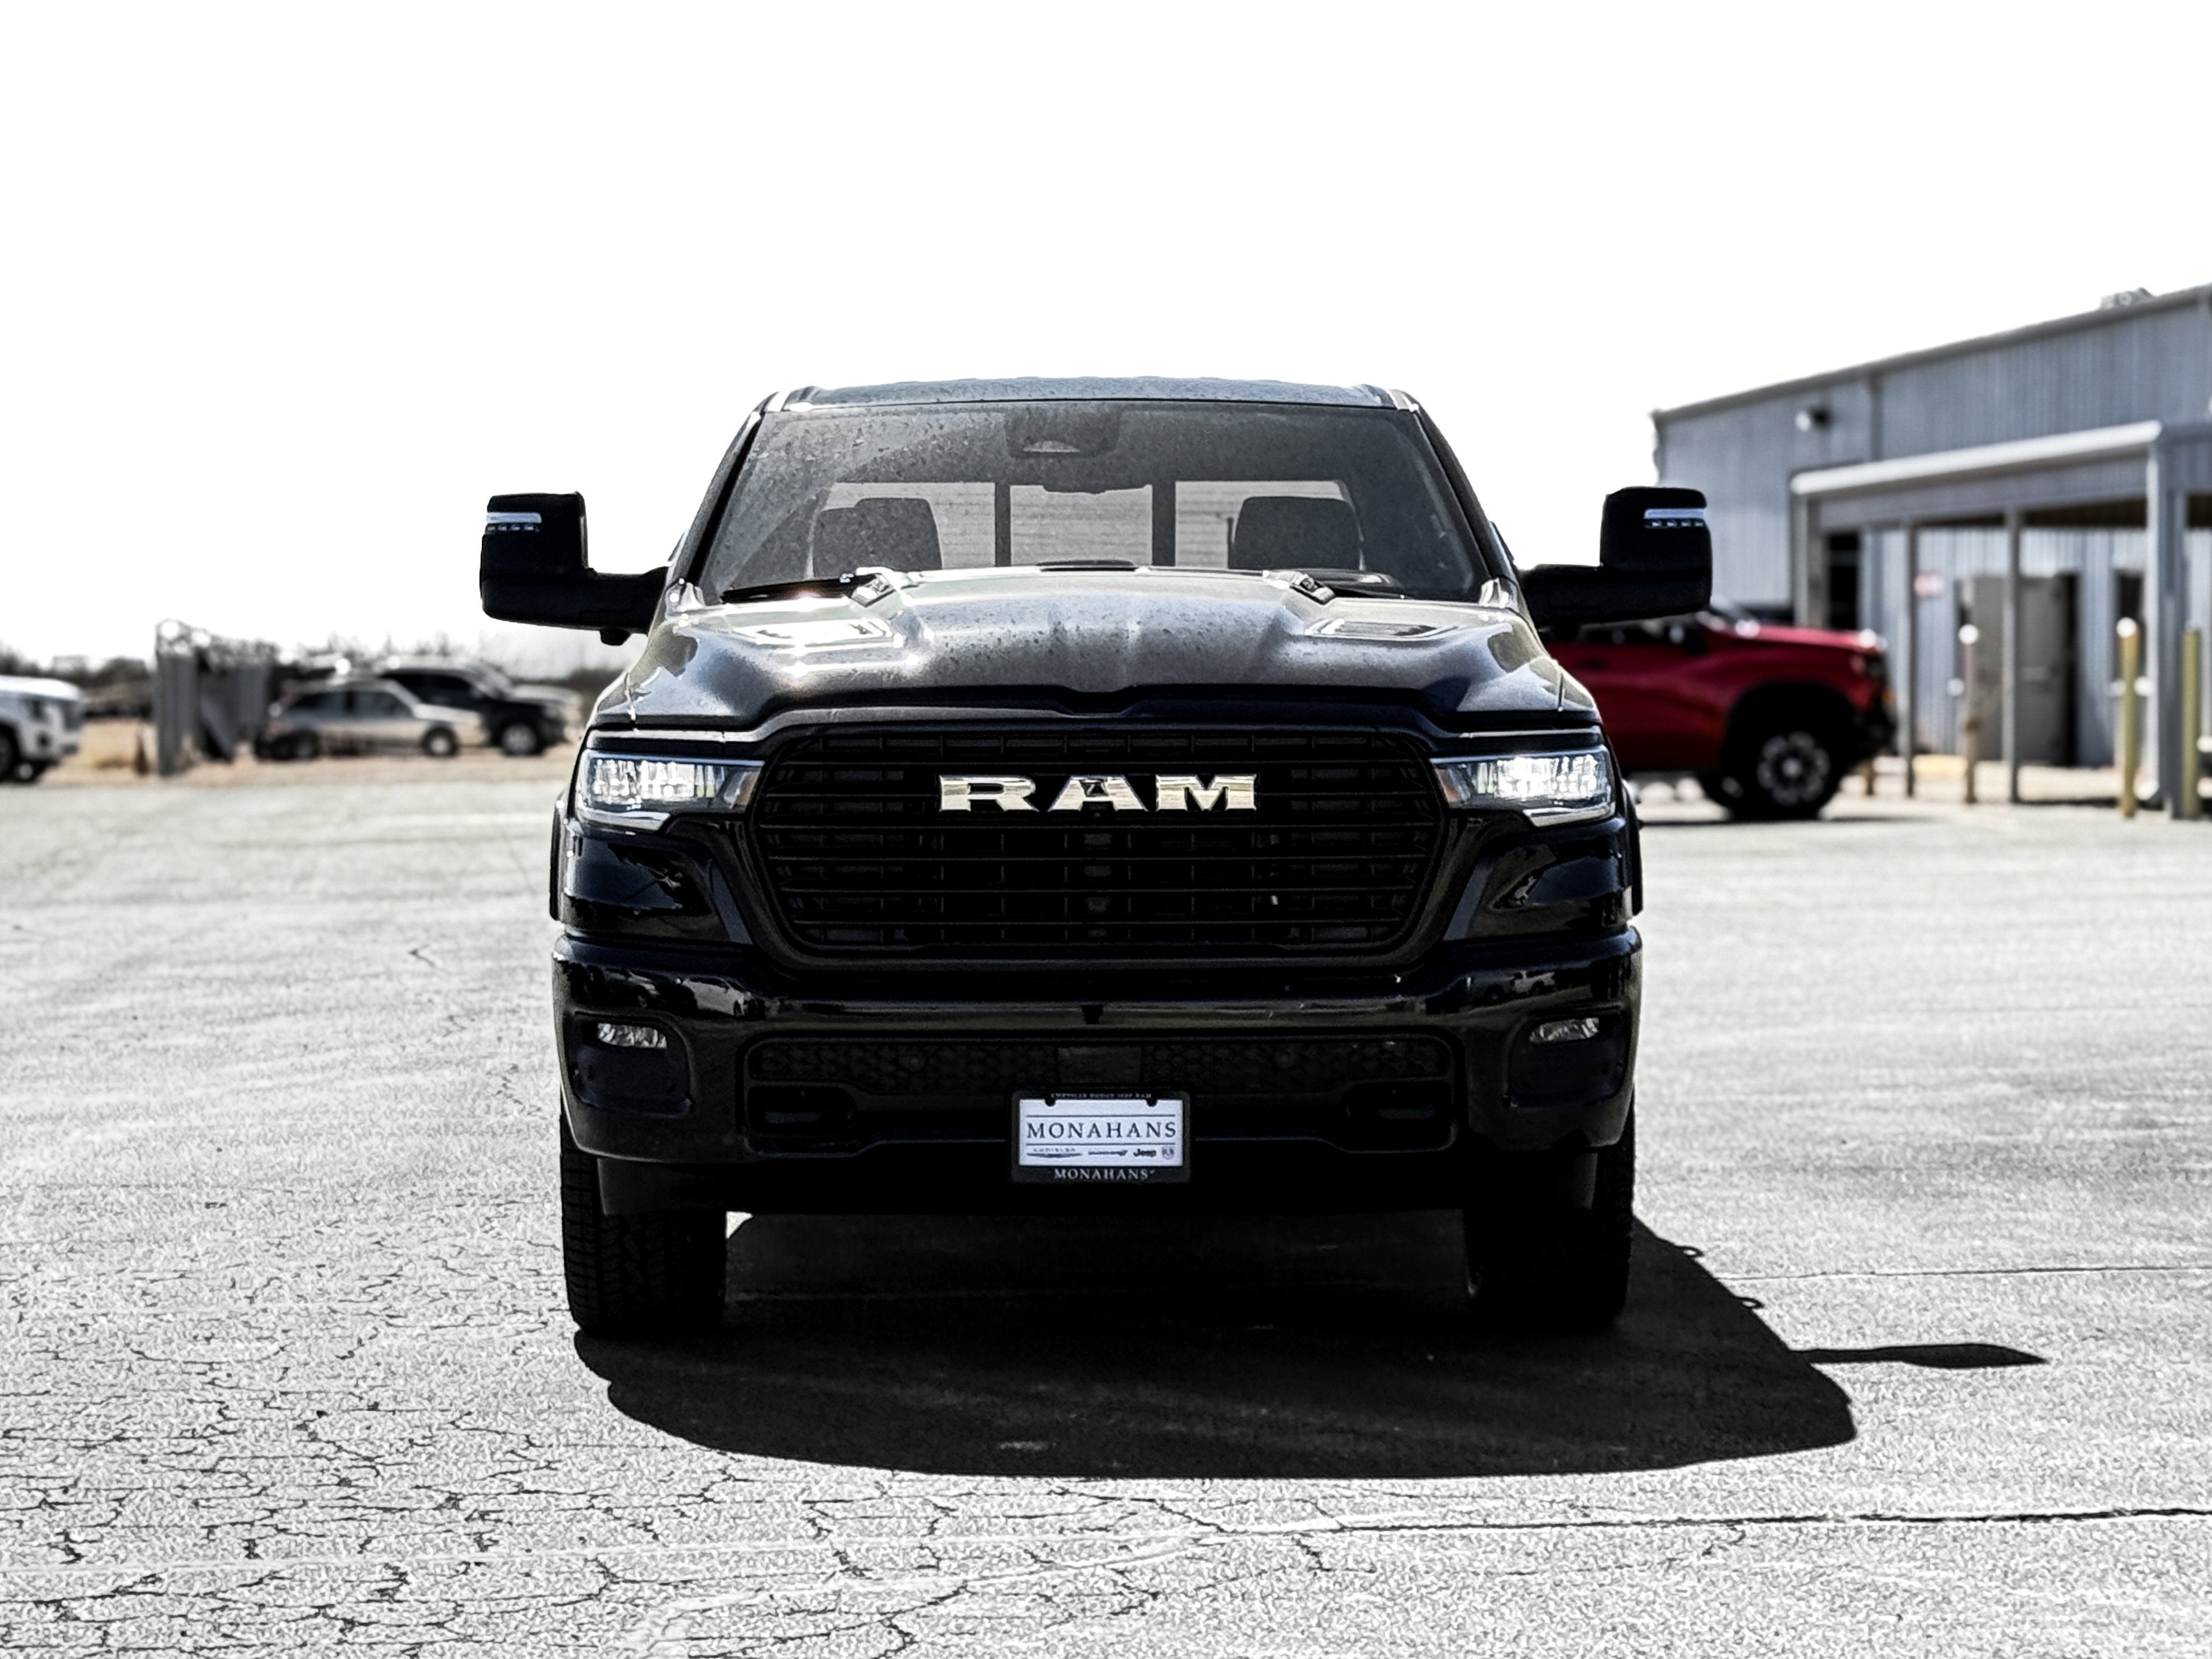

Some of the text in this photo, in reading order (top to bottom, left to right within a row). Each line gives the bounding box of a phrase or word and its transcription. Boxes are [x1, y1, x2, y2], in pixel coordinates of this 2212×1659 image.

[940, 775, 1256, 812] RAM
[1027, 1122, 1176, 1139] MONAHANS
[1054, 1168, 1149, 1180] MONAHANS
